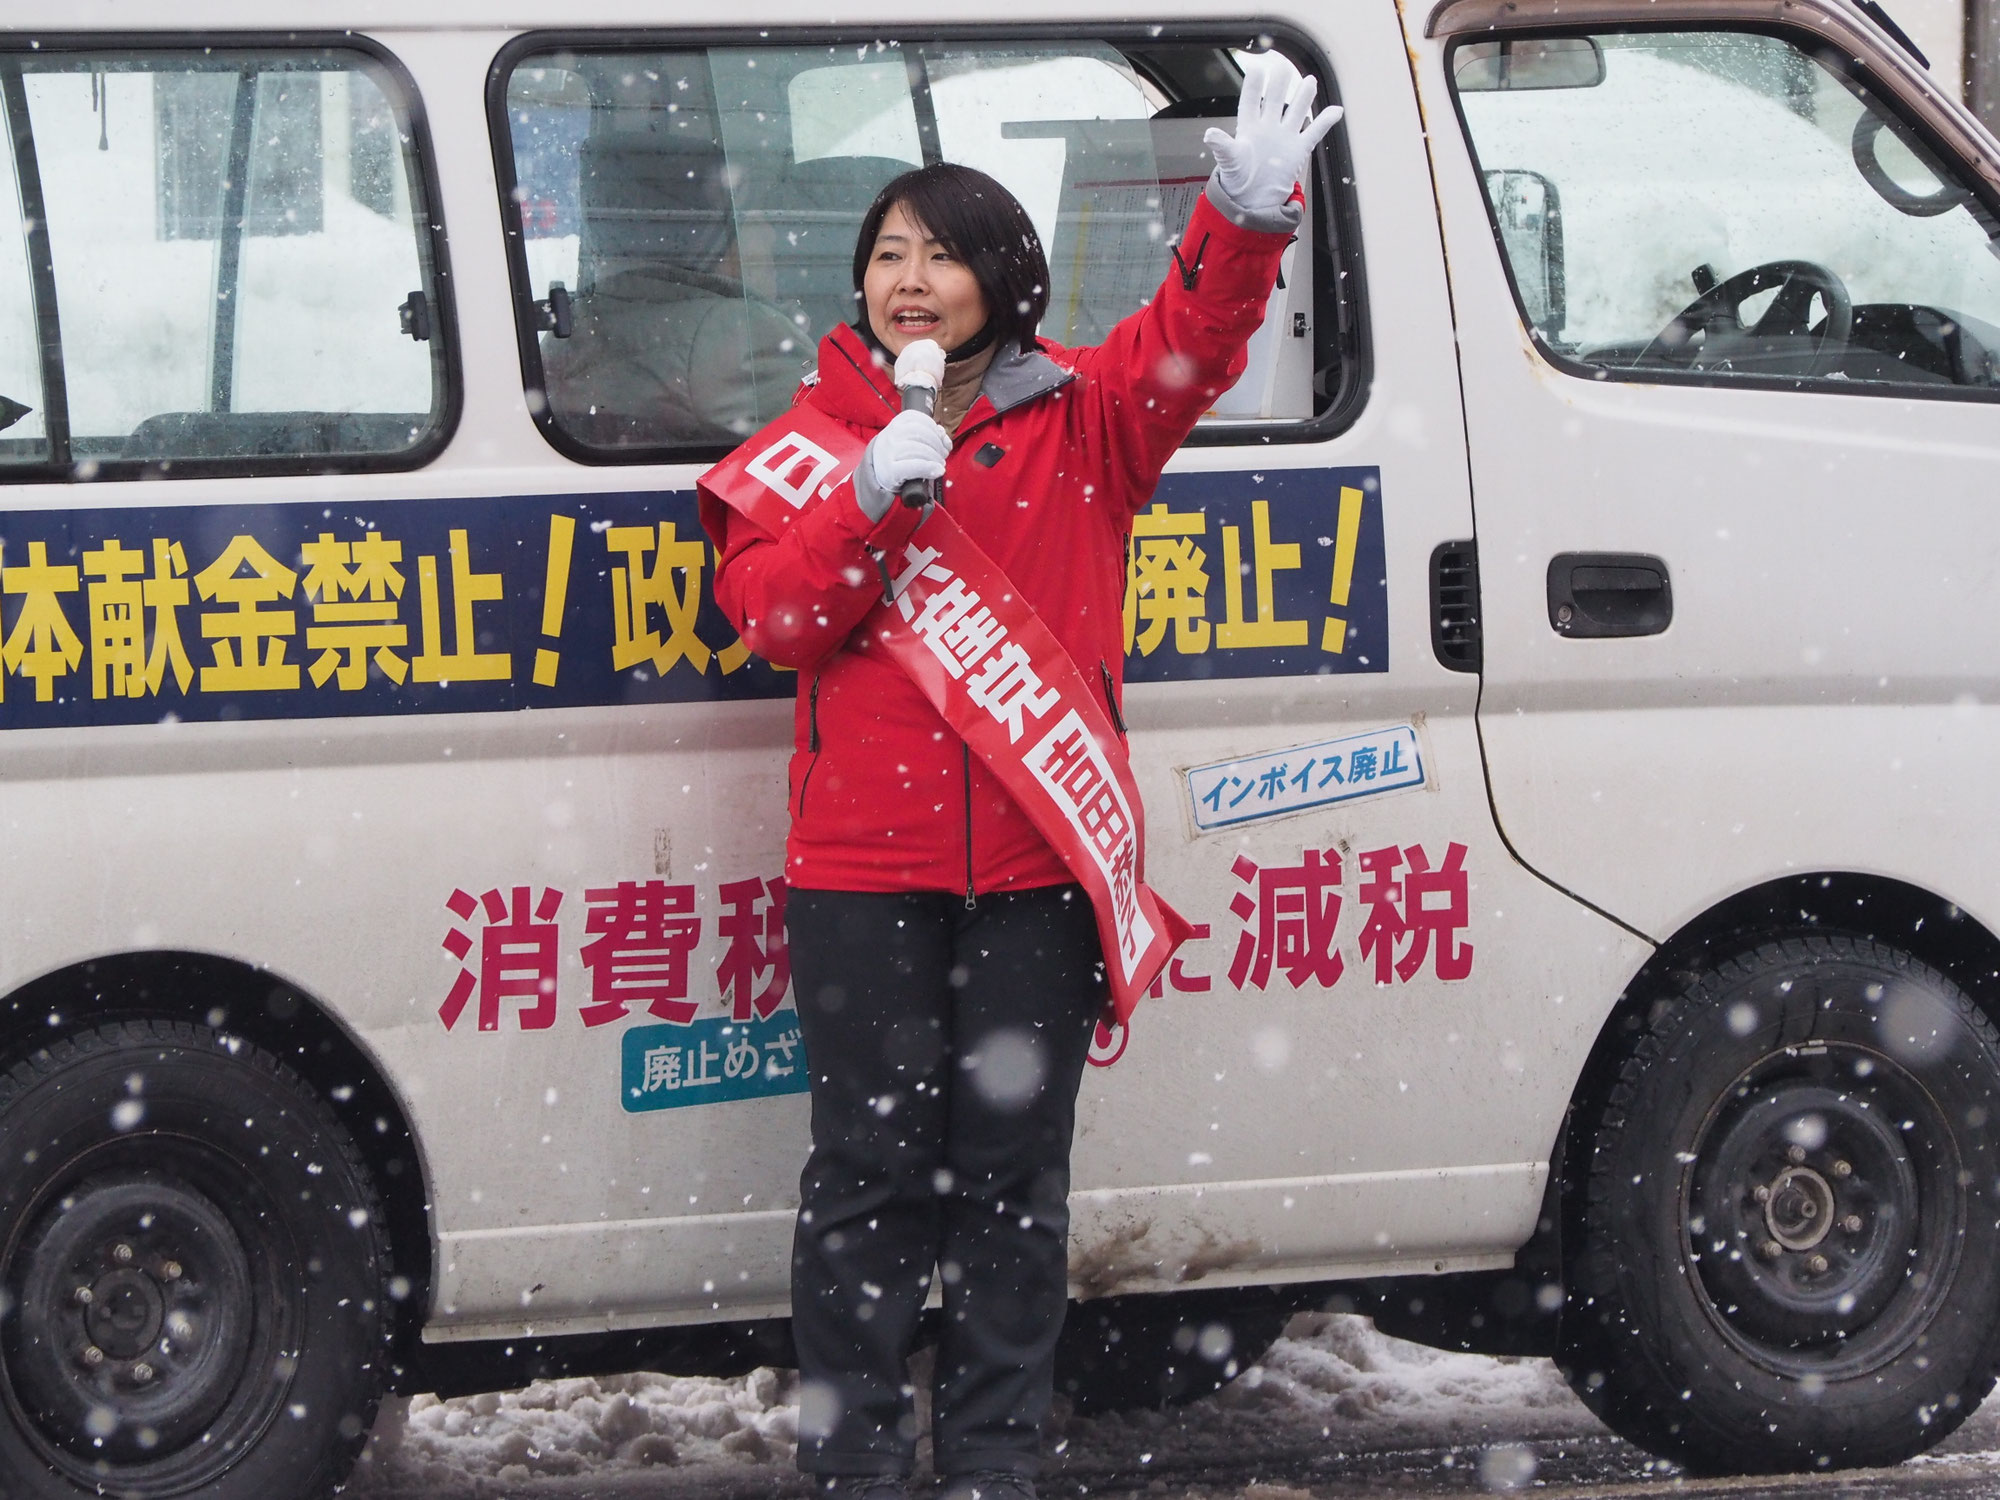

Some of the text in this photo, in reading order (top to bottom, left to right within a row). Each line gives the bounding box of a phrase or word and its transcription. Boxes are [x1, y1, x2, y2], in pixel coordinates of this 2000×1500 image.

[1123, 485, 1364, 658] 廃止！
[1202, 741, 1409, 812] インボイス廃止
